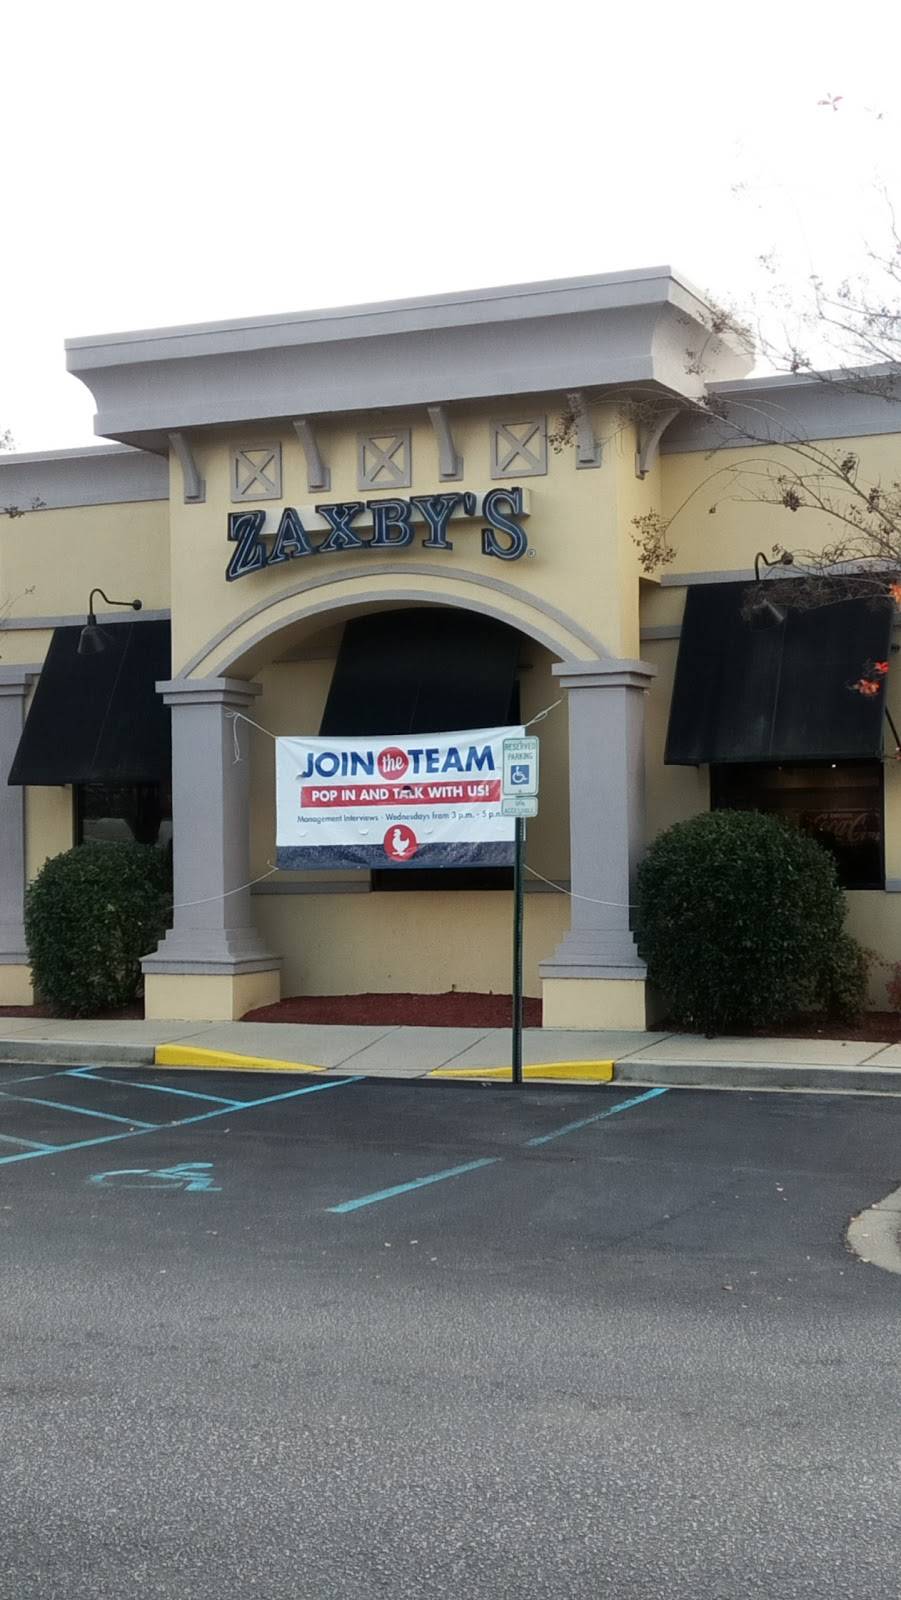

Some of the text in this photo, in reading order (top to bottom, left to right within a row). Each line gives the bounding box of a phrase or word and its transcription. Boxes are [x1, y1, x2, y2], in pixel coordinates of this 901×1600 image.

[226, 487, 527, 582] ZAXBY'S
[504, 743, 536, 751] RESERVED
[303, 745, 495, 777] JOIN the TEAM
[312, 790, 337, 802] POP
[341, 789, 356, 801] IN
[360, 788, 389, 801] AND
[428, 786, 463, 798] WITH
[467, 784, 490, 797] US!
[297, 815, 342, 824] Management
[344, 814, 378, 822] Interviews
[385, 812, 430, 821] Wednesdays
[432, 811, 450, 819] from
[451, 810, 457, 819] 3
[482, 809, 487, 818] 5
